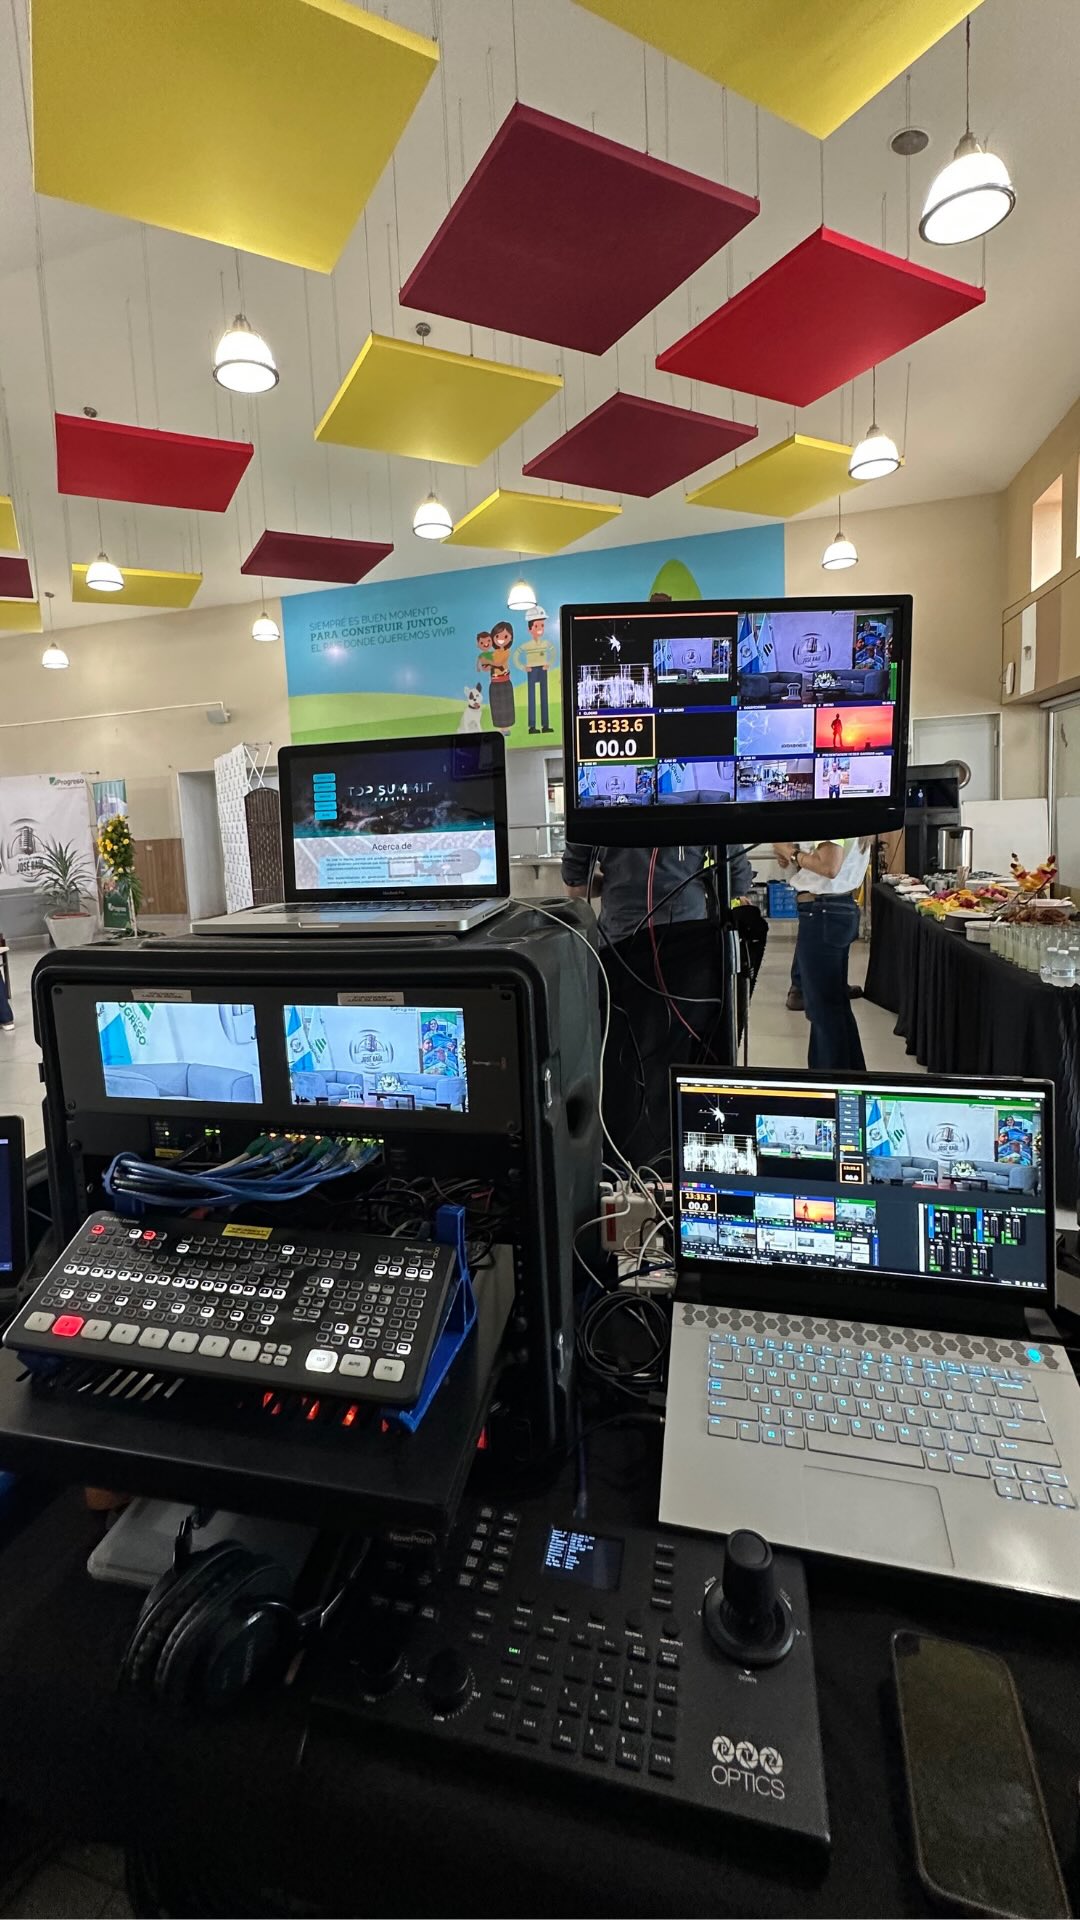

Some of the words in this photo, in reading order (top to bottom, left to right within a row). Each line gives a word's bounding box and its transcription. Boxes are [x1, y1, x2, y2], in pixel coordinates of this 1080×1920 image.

[309, 616, 346, 631] SIEMPRE
[348, 616, 359, 626] ES
[361, 612, 387, 625] BUEN
[389, 606, 438, 621] MOMENTO
[311, 630, 338, 642] PARA
[341, 621, 403, 638] CONSTRUIR
[406, 615, 448, 631] JUNTOS
[311, 644, 321, 653] EL
[377, 629, 430, 645] QUEREMOS
[430, 626, 455, 638] VIVIR
[588, 718, 644, 734] 13:33.6
[595, 738, 637, 758] 00.0
[57, 778, 85, 787] Progreso
[371, 843, 400, 851] Acerca
[402, 842, 413, 850] de
[688, 1201, 709, 1211] 00.0
[658, 1682, 676, 1691] ESCAPE
[655, 1754, 671, 1763] ENTER
[711, 1764, 785, 1801] OPTICS
